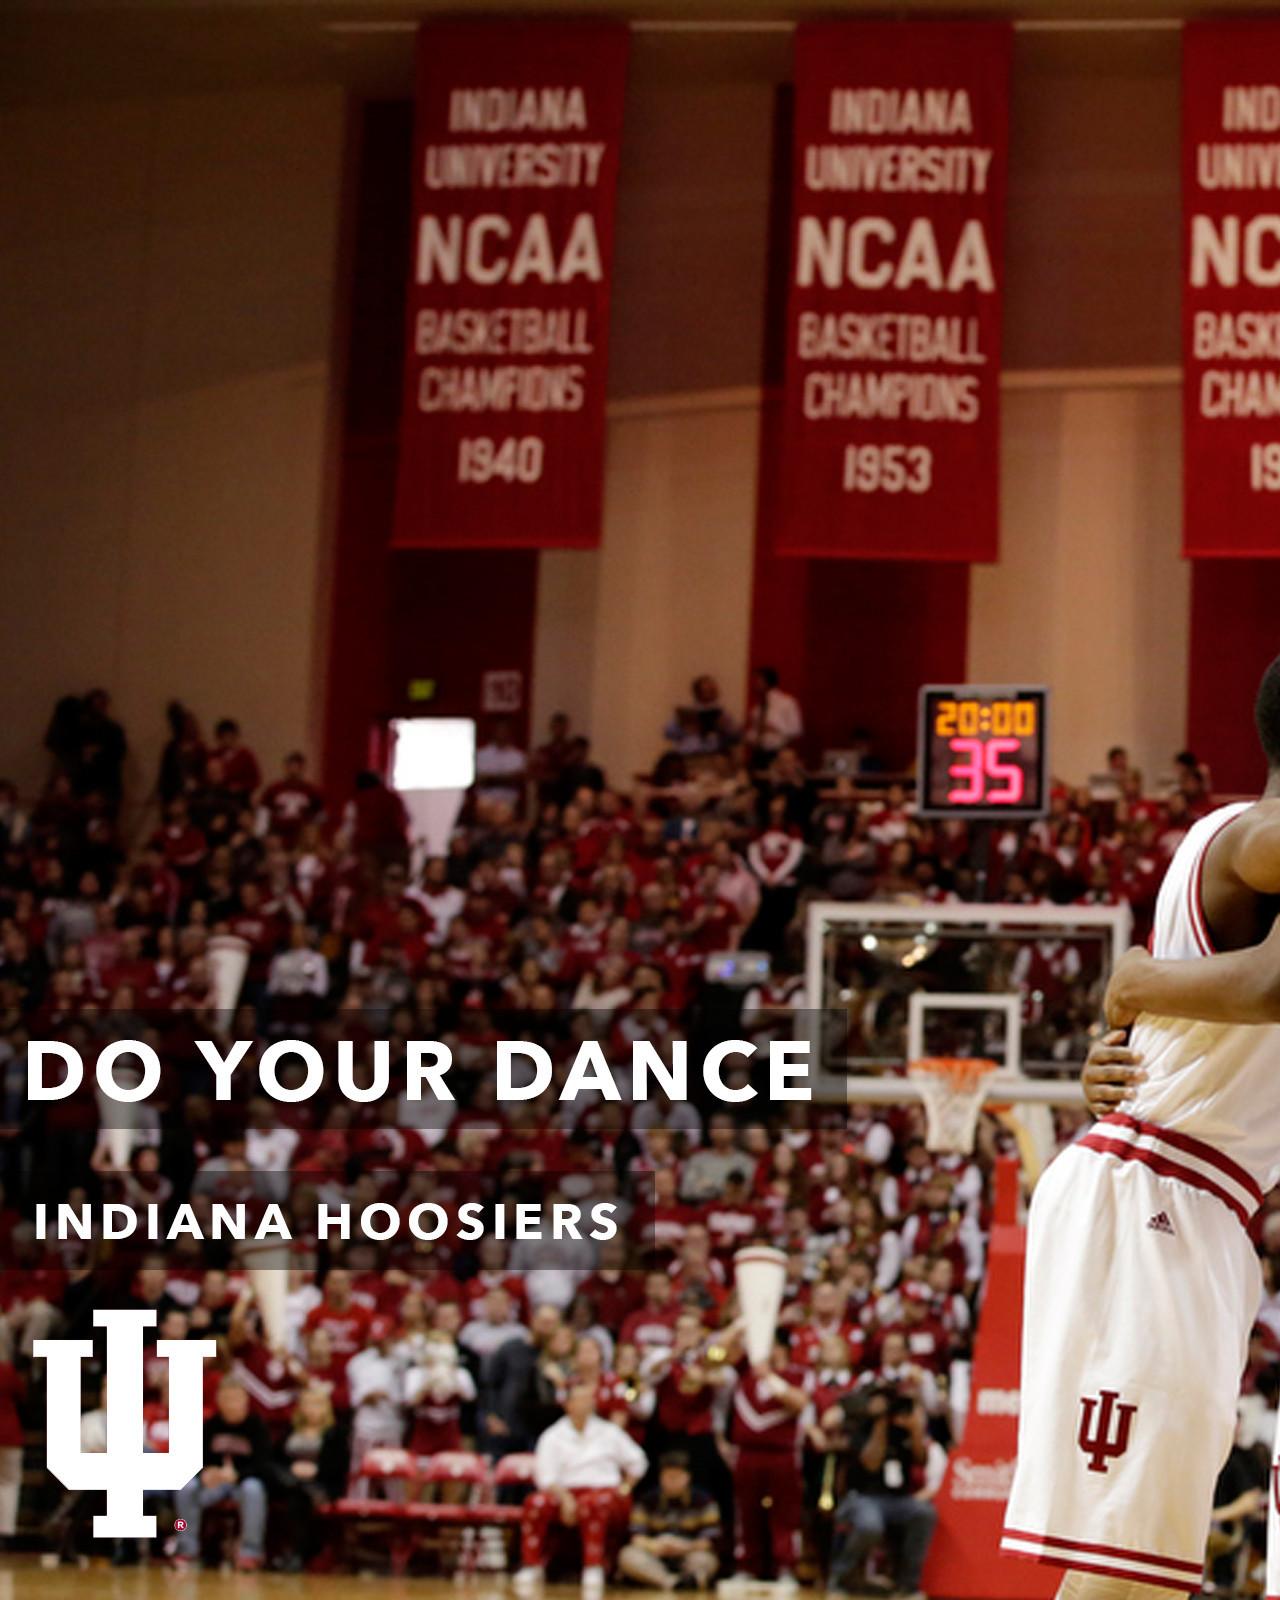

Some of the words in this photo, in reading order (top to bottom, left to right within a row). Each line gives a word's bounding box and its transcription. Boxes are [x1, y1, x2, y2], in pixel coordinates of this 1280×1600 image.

[450, 88, 586, 132] INDIANA
[830, 89, 971, 134] INDIANA
[426, 143, 604, 188] UNIVERSITY
[805, 146, 991, 192] UNIVERSITY
[418, 214, 602, 284] NCAA
[797, 217, 994, 292] NCAA
[416, 308, 592, 355] BASKETBALL
[798, 312, 986, 364] BASKETBALL
[419, 365, 584, 411] CHAMPIONS
[804, 373, 978, 422] CHAMPIONS
[459, 436, 543, 482] 1940
[844, 445, 932, 493] 1953
[935, 701, 1036, 737] 20:00
[949, 738, 1024, 803] 35
